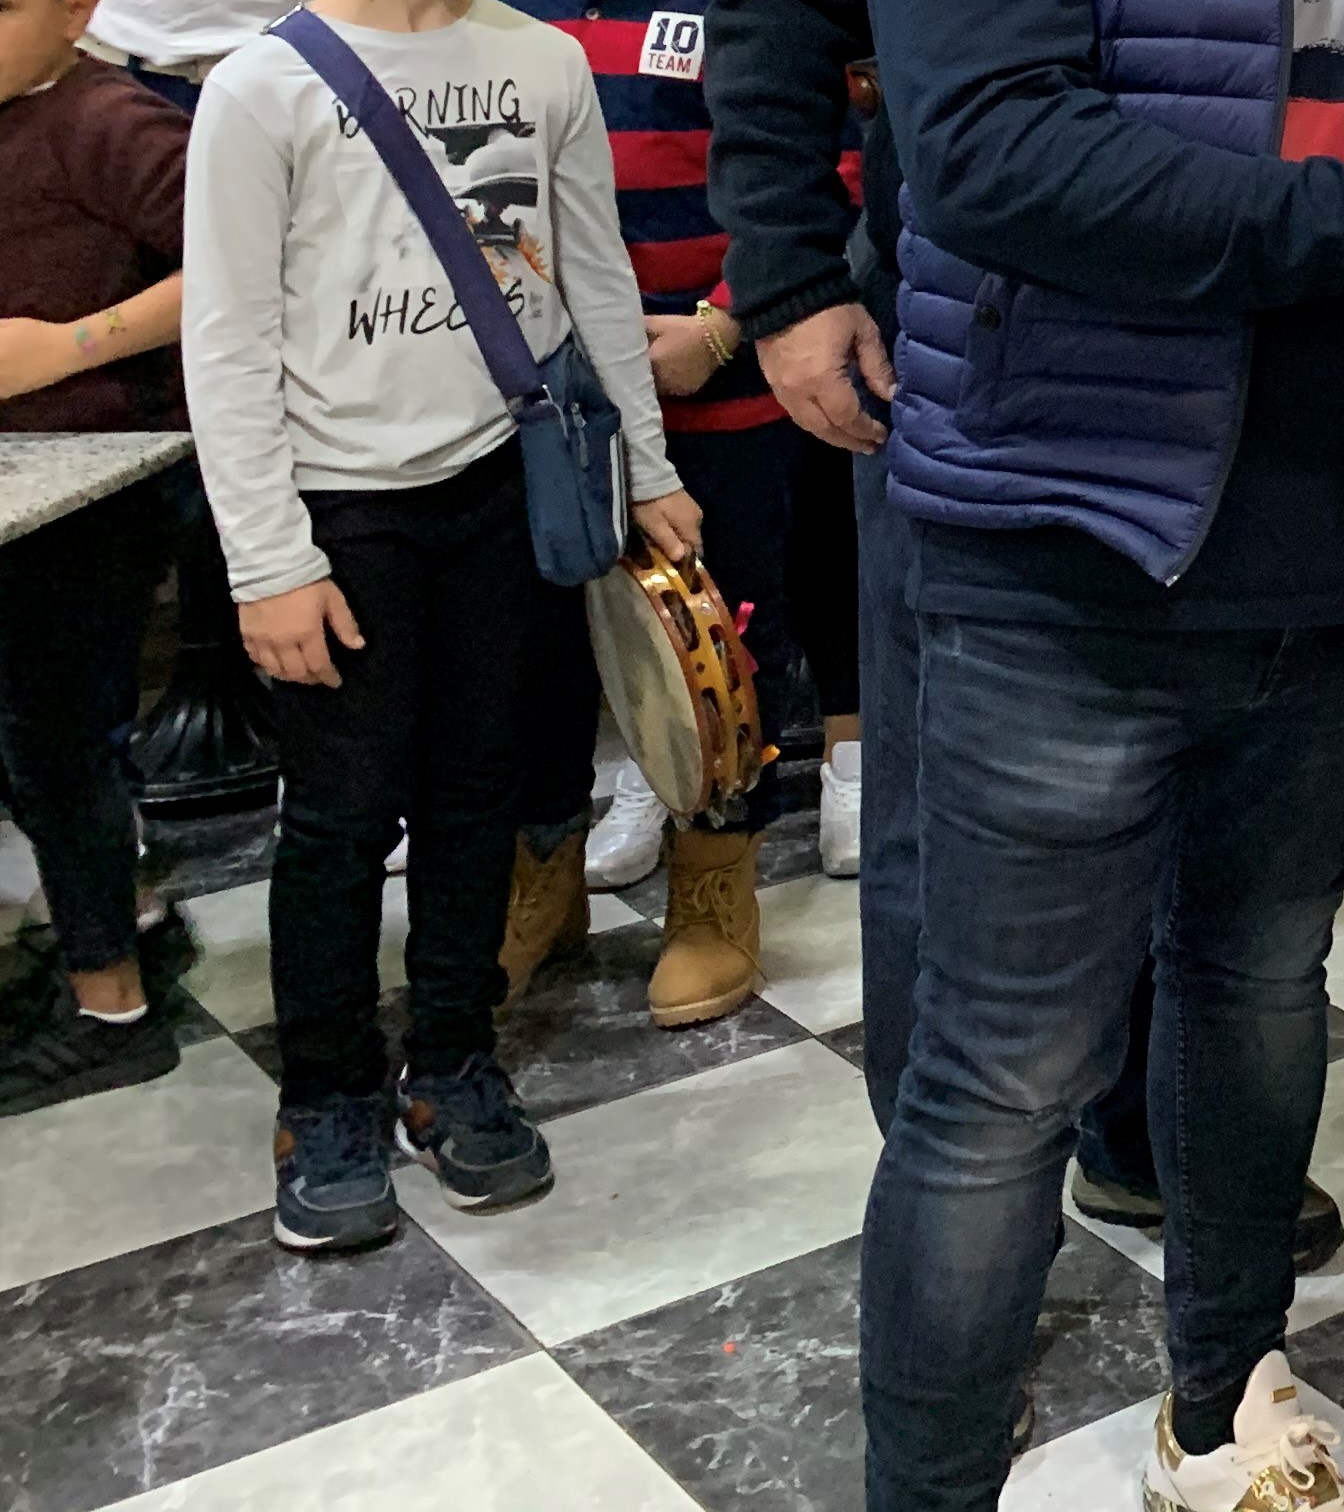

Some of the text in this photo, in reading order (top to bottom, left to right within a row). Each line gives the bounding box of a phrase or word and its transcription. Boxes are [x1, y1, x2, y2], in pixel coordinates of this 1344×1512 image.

[649, 17, 700, 55] 10
[647, 52, 693, 74] TEAM
[331, 78, 522, 140] BRNING
